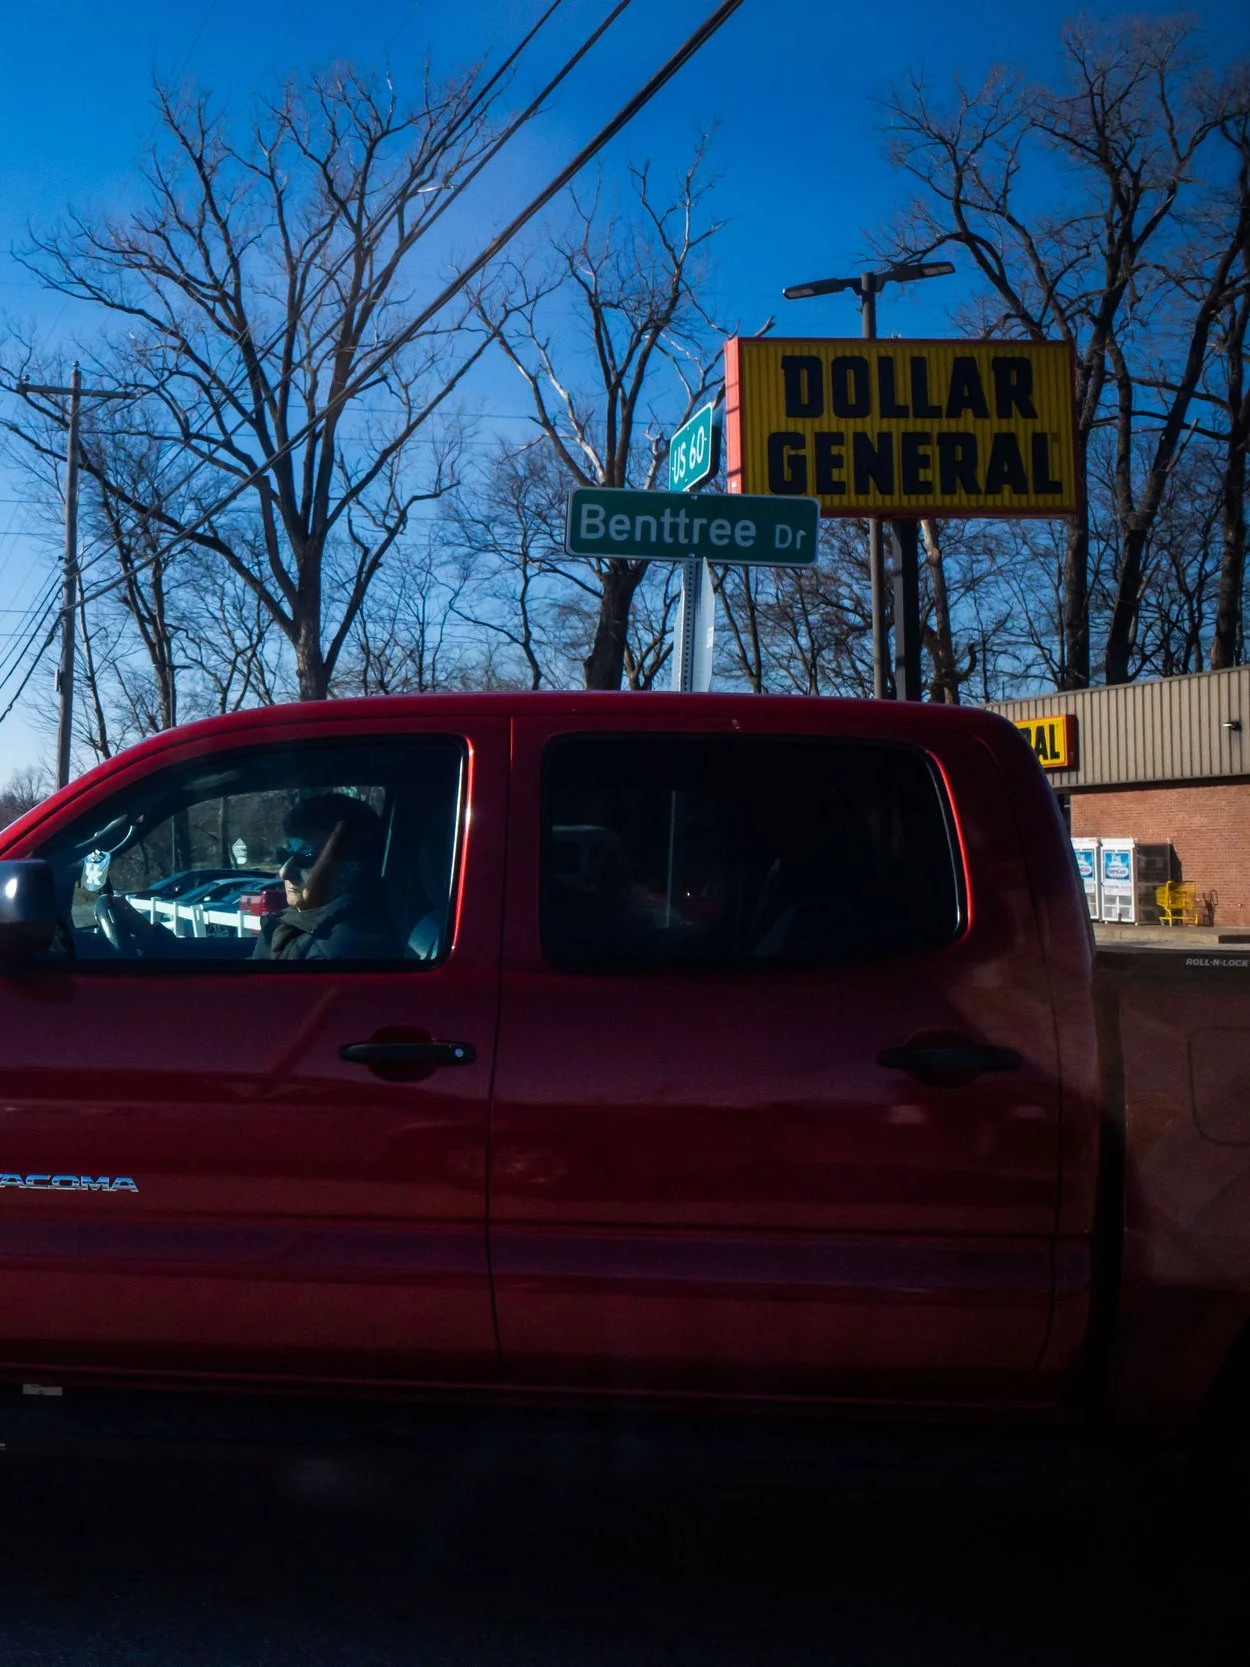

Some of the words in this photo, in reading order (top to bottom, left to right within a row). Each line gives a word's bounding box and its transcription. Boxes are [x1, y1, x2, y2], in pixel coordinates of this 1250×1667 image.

[782, 355, 1038, 419] DOLLAR
[674, 441, 686, 484] US
[689, 425, 705, 470] 60
[767, 431, 1063, 495] GENERAL
[580, 503, 757, 547] Benttree
[775, 524, 807, 549] Dr
